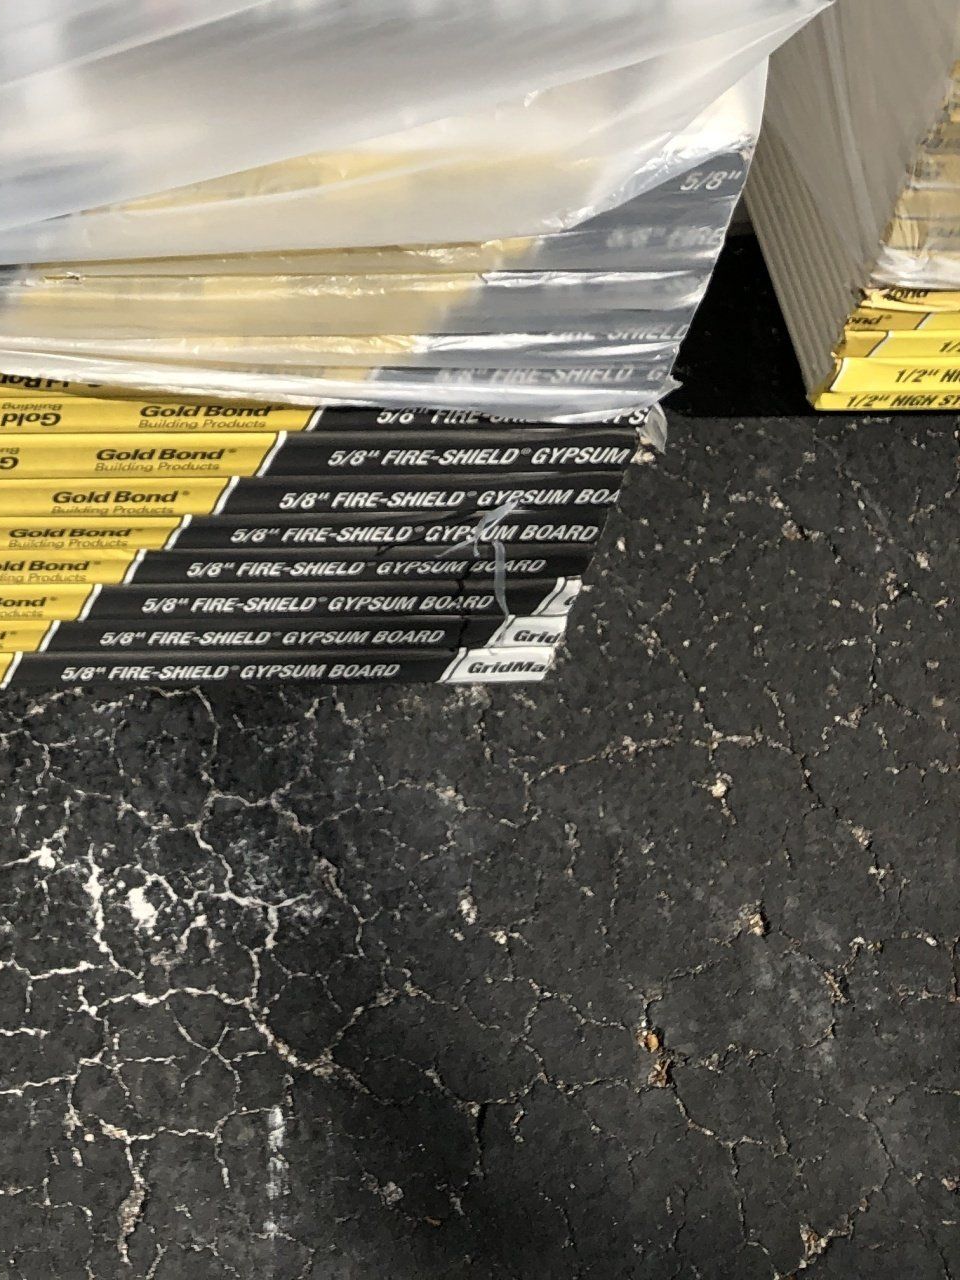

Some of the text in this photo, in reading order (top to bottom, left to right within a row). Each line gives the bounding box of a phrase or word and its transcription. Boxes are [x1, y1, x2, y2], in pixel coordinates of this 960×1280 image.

[0, 410, 63, 427] Gold
[139, 405, 272, 420] Gold Bond
[95, 447, 225, 462] Gold Bond
[327, 448, 379, 468] 5/8"
[529, 445, 627, 465] GYPSUM
[51, 490, 178, 504] Gold Bond
[278, 491, 331, 510] 5/8"
[477, 488, 573, 507] GYPSUM
[577, 487, 621, 505] BOA
[8, 526, 131, 539] Gold Bond
[230, 526, 280, 544] 5/8"
[518, 524, 599, 542] BOARD
[28, 559, 91, 572] Bond
[186, 559, 237, 578] 5/8"
[377, 557, 464, 576] GYPSUM
[142, 595, 190, 615] 5/8"
[327, 594, 415, 612] GYPSUM
[417, 593, 495, 611] BOARD
[100, 630, 147, 647] 5/8"
[281, 629, 368, 646] GYPSUM
[371, 628, 446, 645] BOARD
[61, 665, 107, 683] 5/8"
[238, 664, 323, 681] GYPSUM
[325, 663, 400, 680] BOARD
